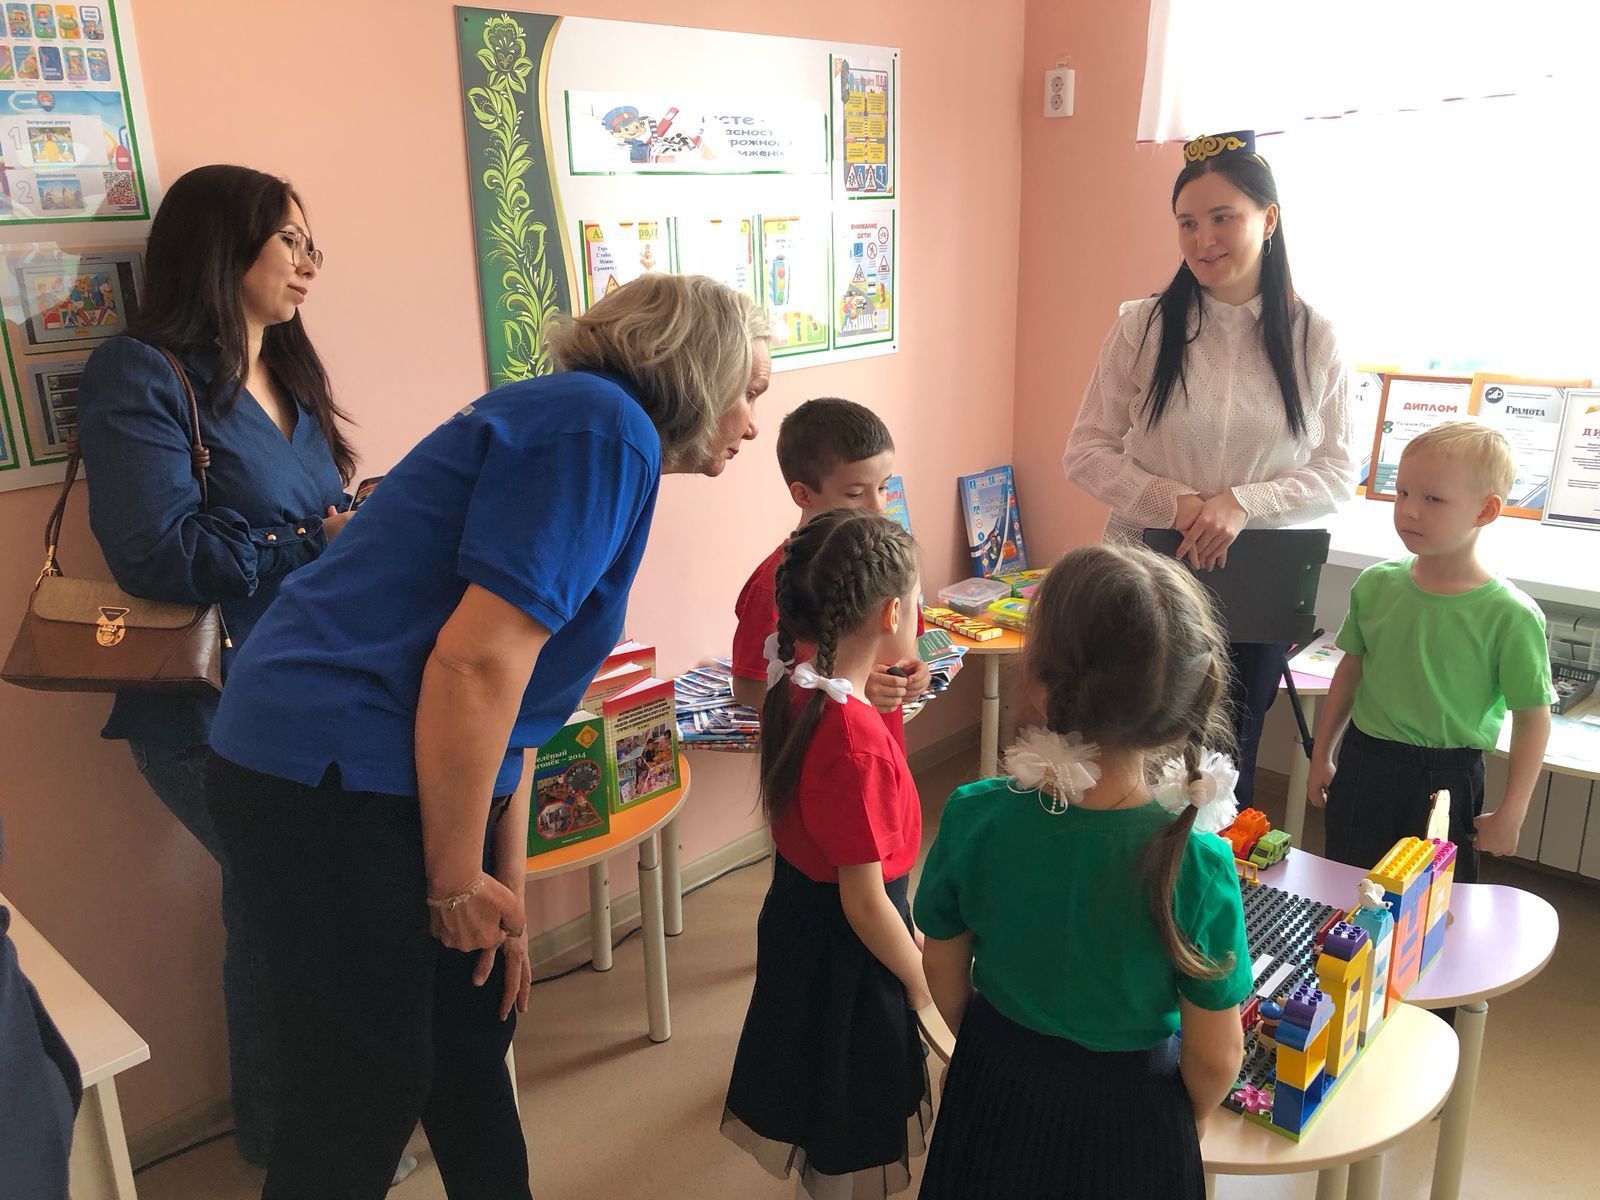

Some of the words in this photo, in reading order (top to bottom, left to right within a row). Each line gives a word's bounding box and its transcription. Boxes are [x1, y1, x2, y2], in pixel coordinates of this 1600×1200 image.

[1403, 402, 1458, 413] ДИПЛОМ
[537, 749, 568, 763] елёный
[537, 759, 560, 769] гонёк
[568, 752, 586, 761] 2014
